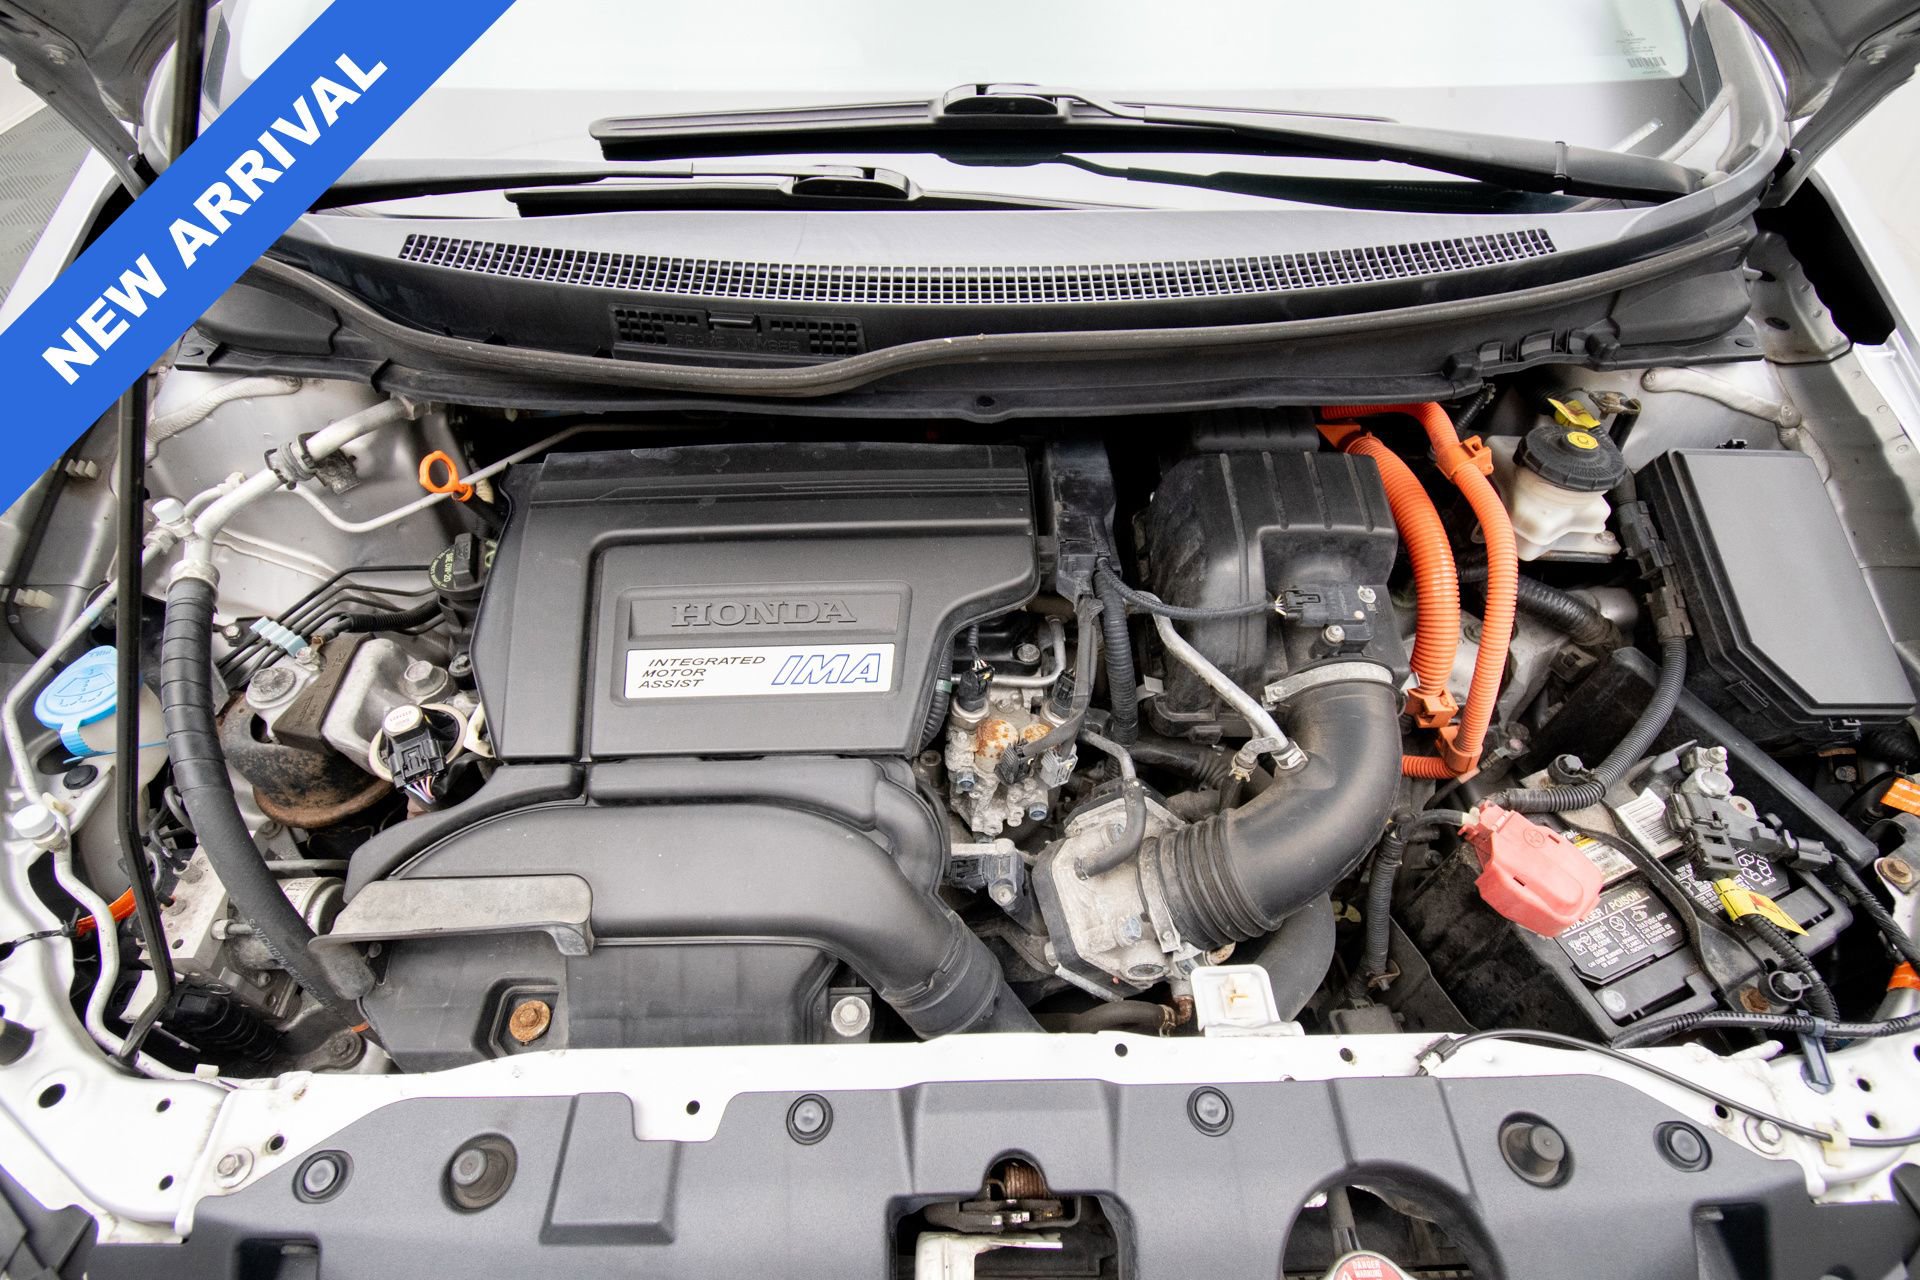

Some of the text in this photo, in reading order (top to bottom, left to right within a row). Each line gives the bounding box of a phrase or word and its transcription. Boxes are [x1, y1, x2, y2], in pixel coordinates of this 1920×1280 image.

[671, 599, 857, 627] HONDA
[648, 655, 766, 667] INTEGRATED
[770, 653, 881, 685] IMA
[641, 668, 707, 678] MOTOR
[637, 678, 705, 689] ASSIST
[1607, 890, 1641, 911] POISON
